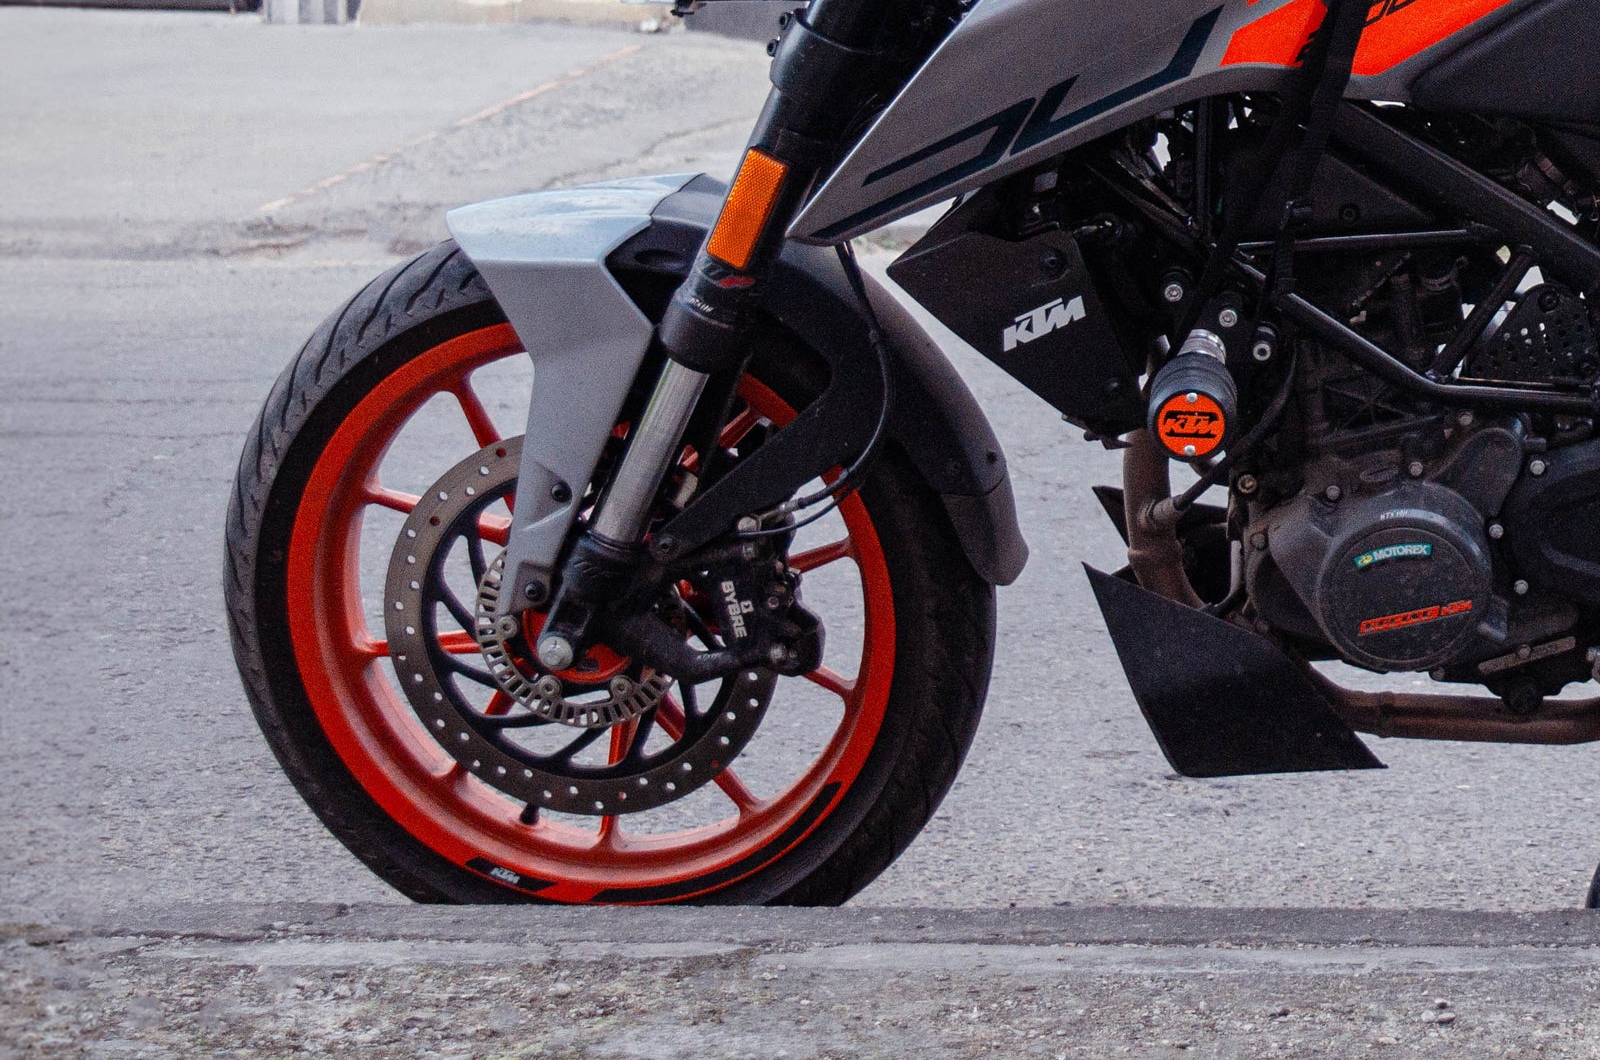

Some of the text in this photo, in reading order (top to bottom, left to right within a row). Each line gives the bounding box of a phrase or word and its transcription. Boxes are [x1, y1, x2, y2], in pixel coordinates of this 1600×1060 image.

[1002, 295, 1086, 353] KTM
[1163, 412, 1218, 436] KTM
[1372, 543, 1429, 560] MOTOREX
[721, 580, 748, 638] BYBRE
[490, 866, 521, 885] KTM
